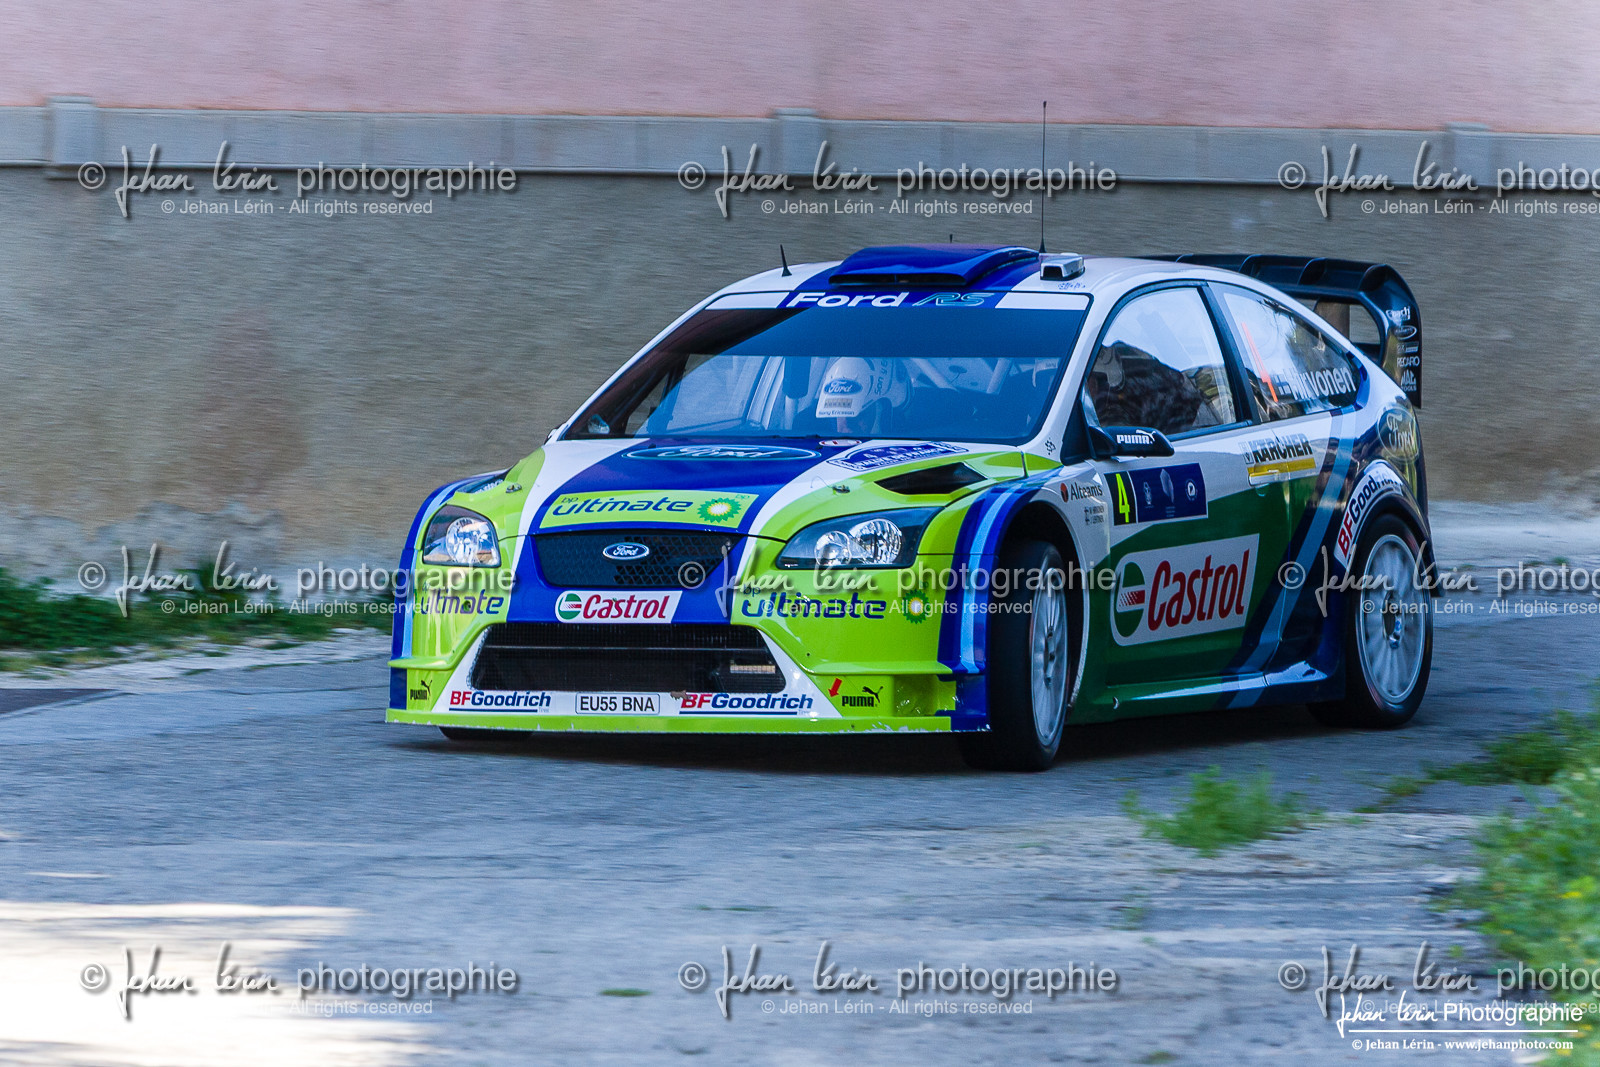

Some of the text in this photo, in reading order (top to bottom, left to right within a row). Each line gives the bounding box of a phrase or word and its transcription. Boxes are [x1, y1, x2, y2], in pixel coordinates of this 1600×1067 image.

[786, 291, 995, 308] Ford RS
[827, 380, 853, 393] Ford
[1116, 434, 1150, 445] PUMA
[656, 447, 783, 458] Ford
[1070, 482, 1103, 501] Alteams
[1115, 473, 1131, 523] 4
[552, 496, 694, 517] ultimate
[1147, 548, 1250, 632] Castrol
[582, 594, 670, 620] Castrol
[741, 591, 888, 620] ultimate
[449, 690, 552, 707] BFGoodrich
[580, 695, 656, 712] EU55 BNA
[681, 693, 814, 710] BFGoodrich
[841, 695, 875, 708] PUMA
